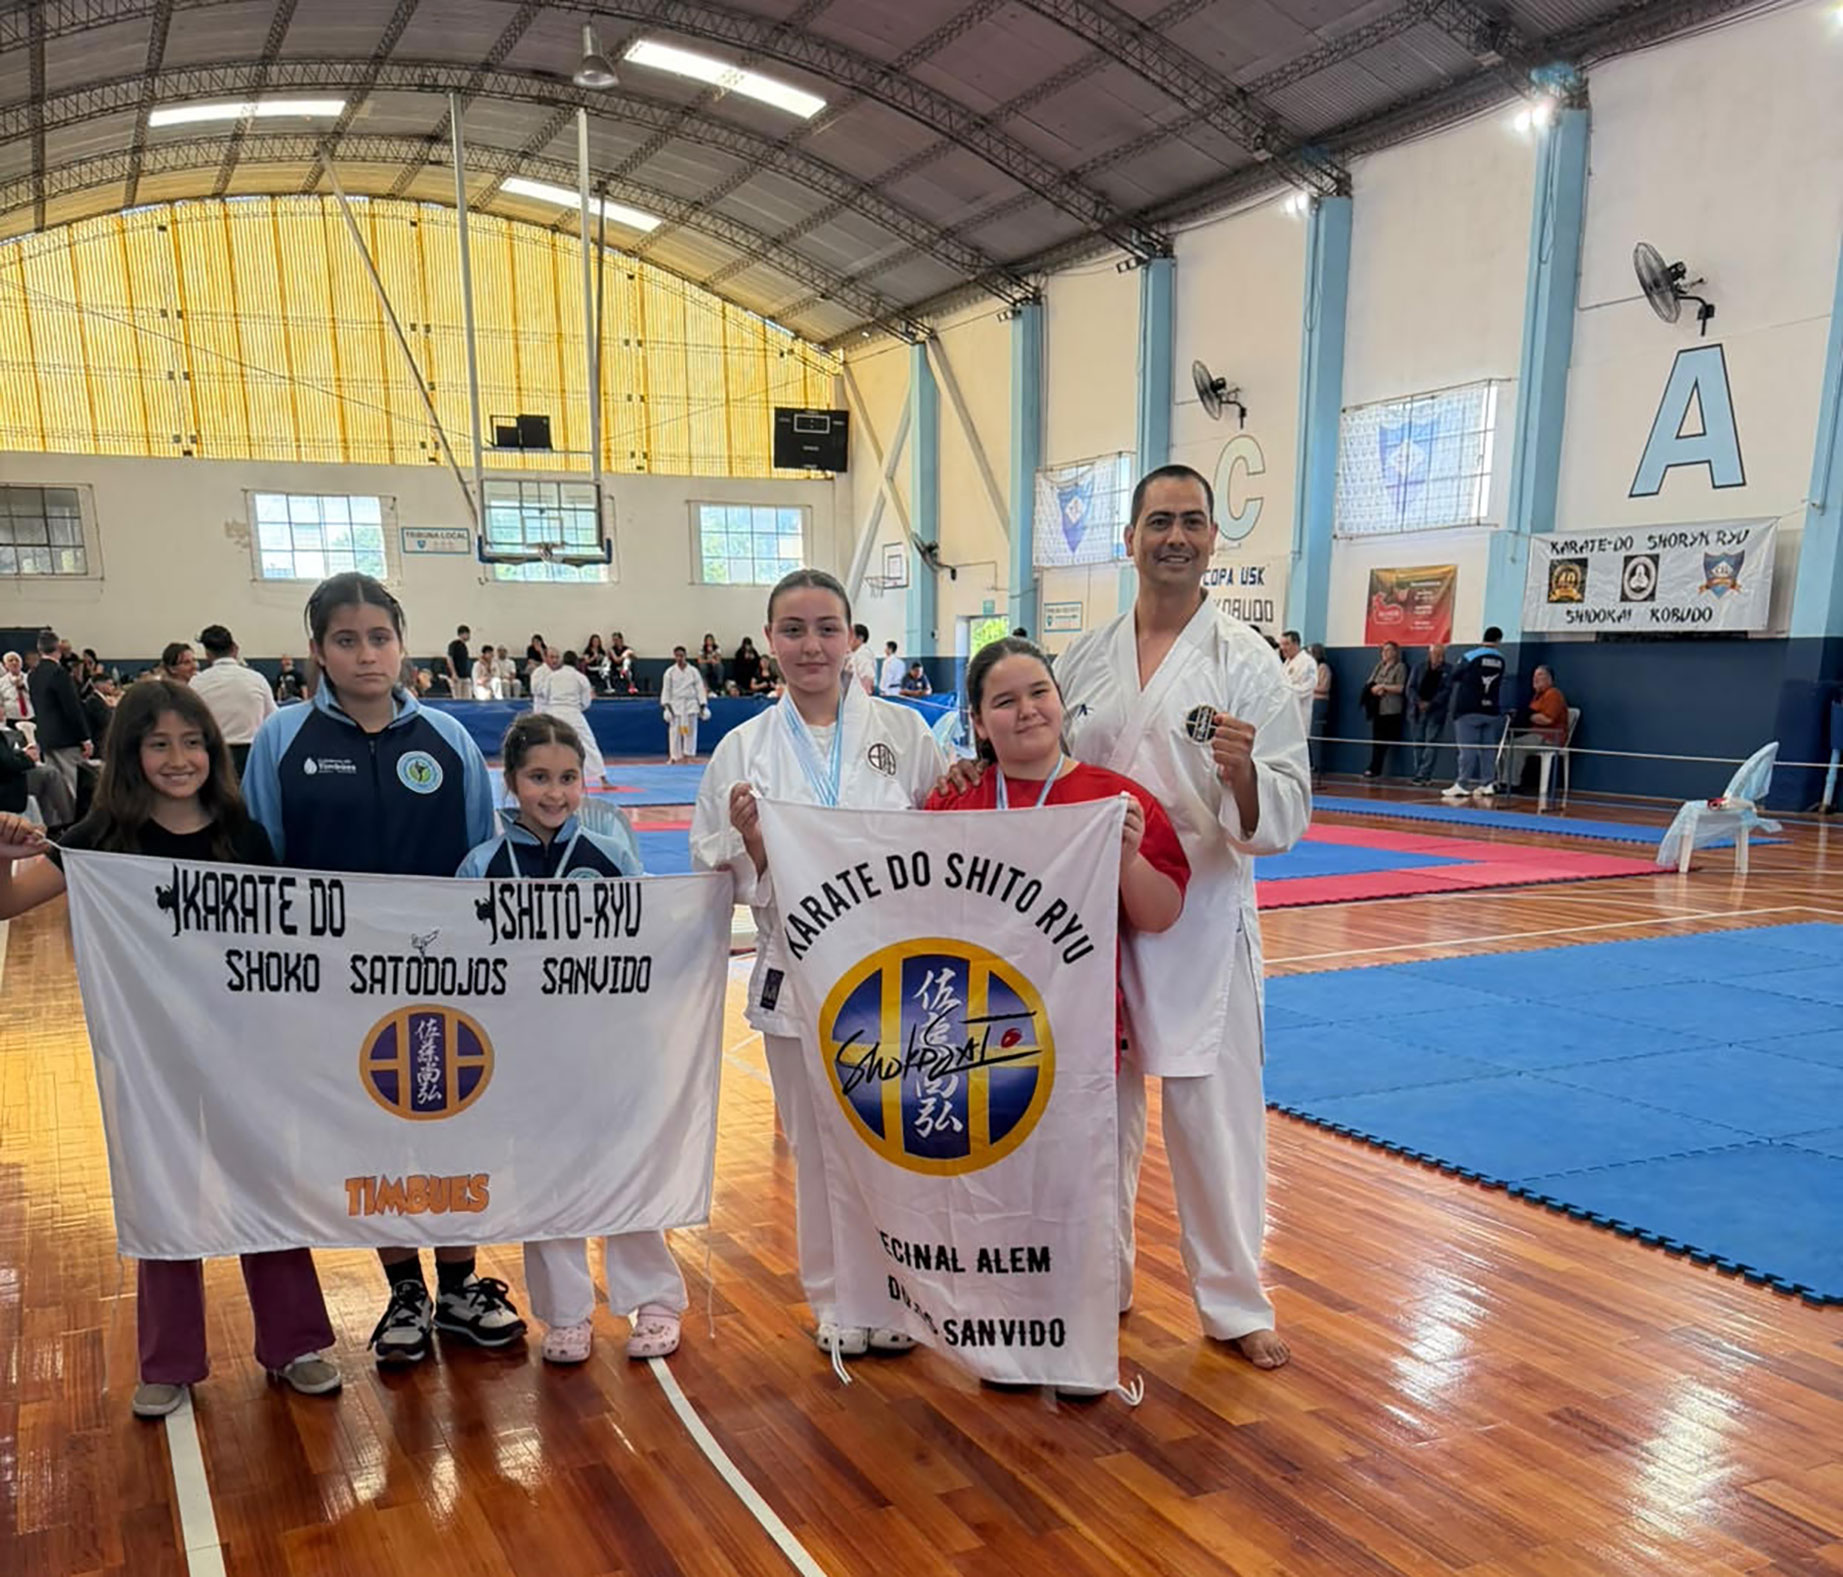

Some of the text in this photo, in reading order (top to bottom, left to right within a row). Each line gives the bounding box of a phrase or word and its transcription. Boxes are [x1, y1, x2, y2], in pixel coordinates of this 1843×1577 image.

[1628, 343, 1748, 498] A
[1214, 434, 1266, 541] C
[440, 531, 467, 540] LOCAL
[1550, 535, 1634, 554] KARATE-DO
[1717, 530, 1750, 545] RYU
[1203, 566, 1265, 586] COPA USK
[1651, 606, 1713, 623] KOBUDO
[183, 869, 642, 940] KARATE DO SHITO-RYU
[784, 851, 1095, 965] KARATE DO SHITO RYU
[226, 949, 320, 993] SHOKO
[541, 955, 652, 995] SANVIDO
[345, 1173, 490, 1217] TIMBUES
[878, 1229, 1051, 1275] ECINAL ALEM
[943, 1318, 1067, 1348] SANVIDO
